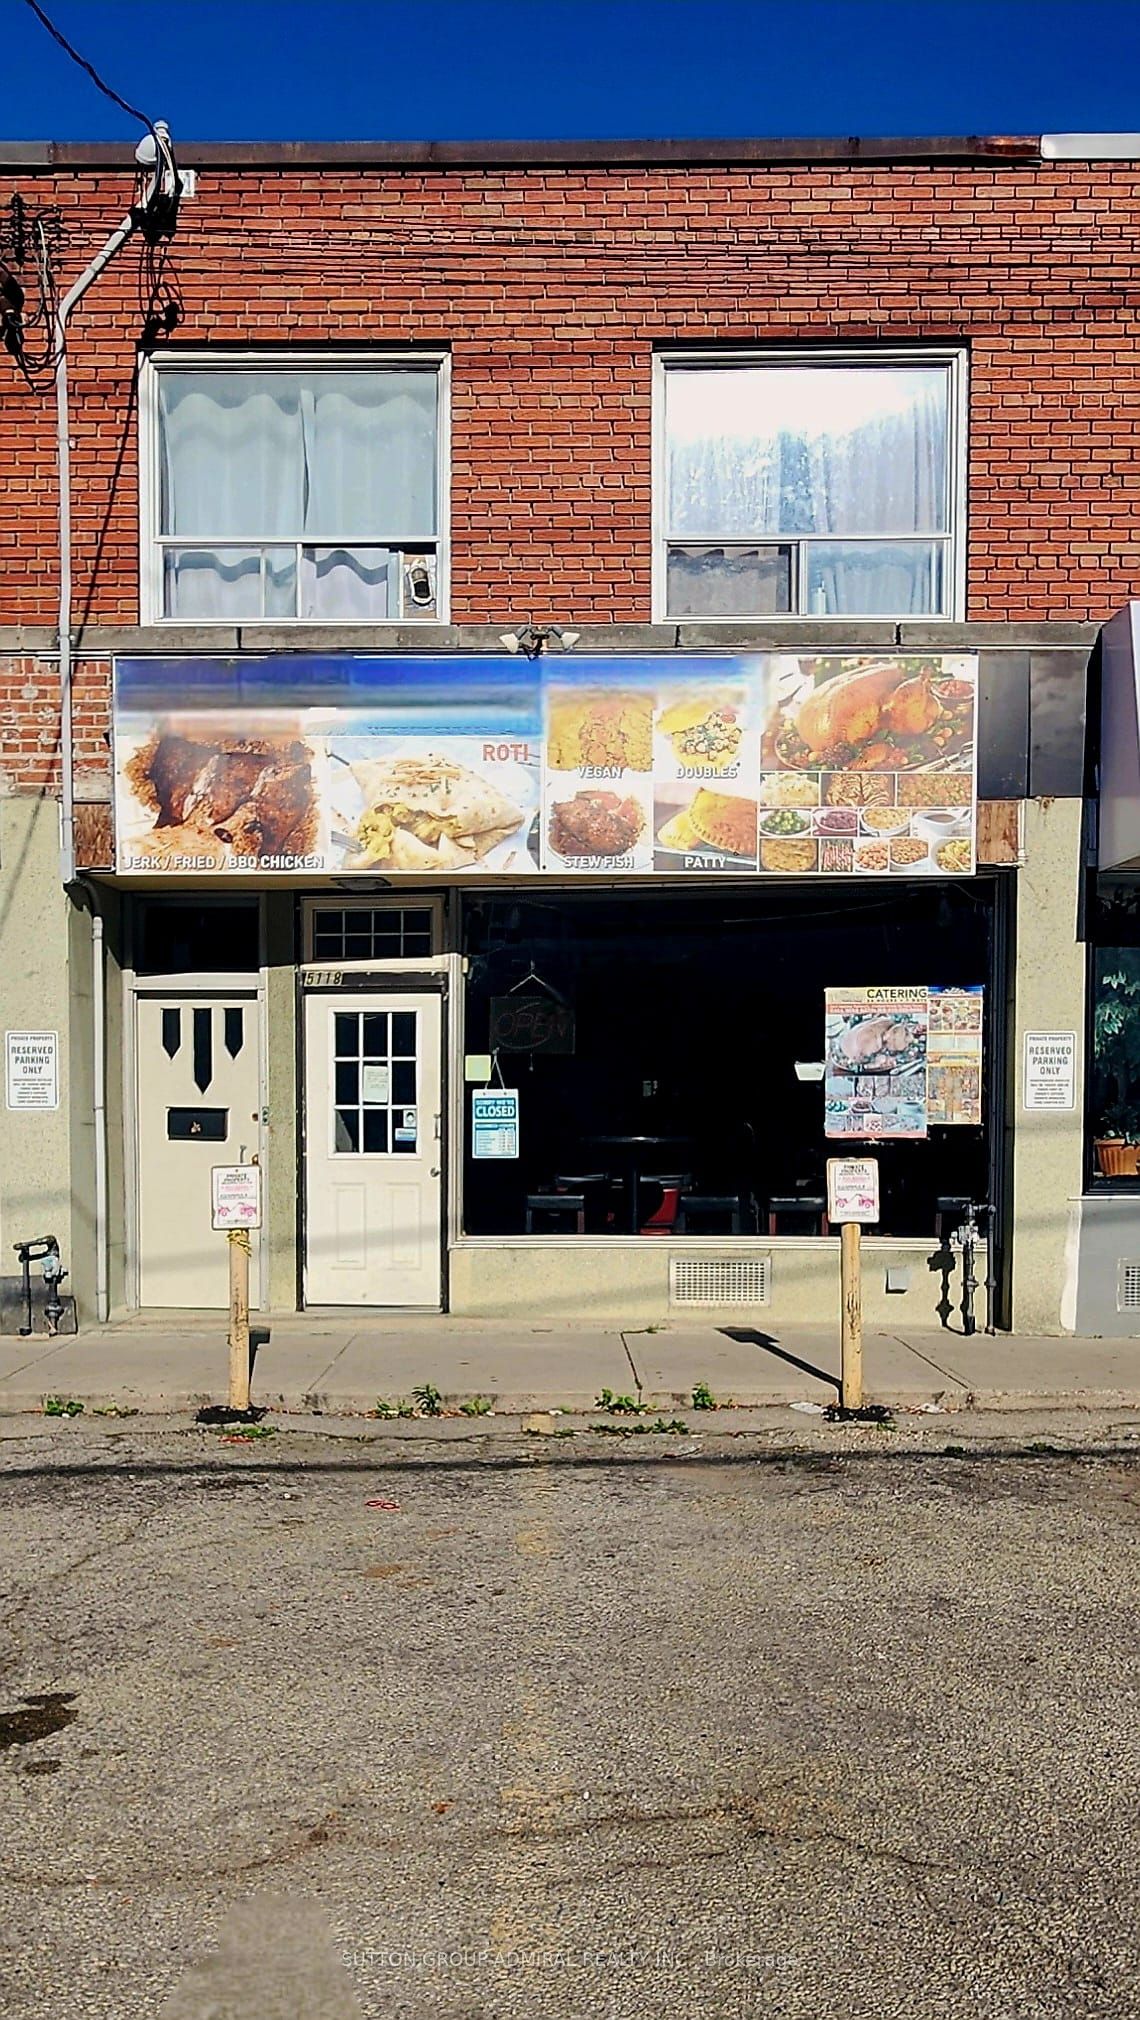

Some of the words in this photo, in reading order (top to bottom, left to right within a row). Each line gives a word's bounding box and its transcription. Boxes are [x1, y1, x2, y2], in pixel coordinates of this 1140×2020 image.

[483, 744, 529, 761] ROTI
[579, 767, 623, 779] VEGAN
[676, 767, 738, 780] DOUBLES
[125, 855, 163, 870] JERK
[173, 855, 216, 869] FRIED
[228, 855, 258, 869] BBQ
[260, 855, 324, 869] CHICKEN
[564, 855, 603, 868] STEW
[604, 855, 634, 868] FISH
[684, 856, 726, 868] PATTY
[306, 972, 342, 985] 5118
[867, 988, 927, 998] CATERING
[11, 1046, 54, 1054] RESERVED
[1029, 1046, 1072, 1055] RESERVED
[15, 1056, 50, 1064] PARKING
[1032, 1056, 1068, 1065] PARKING
[22, 1066, 42, 1074] ONLY
[1040, 1066, 1060, 1075] ONLY
[476, 1105, 515, 1117] CLOSED
